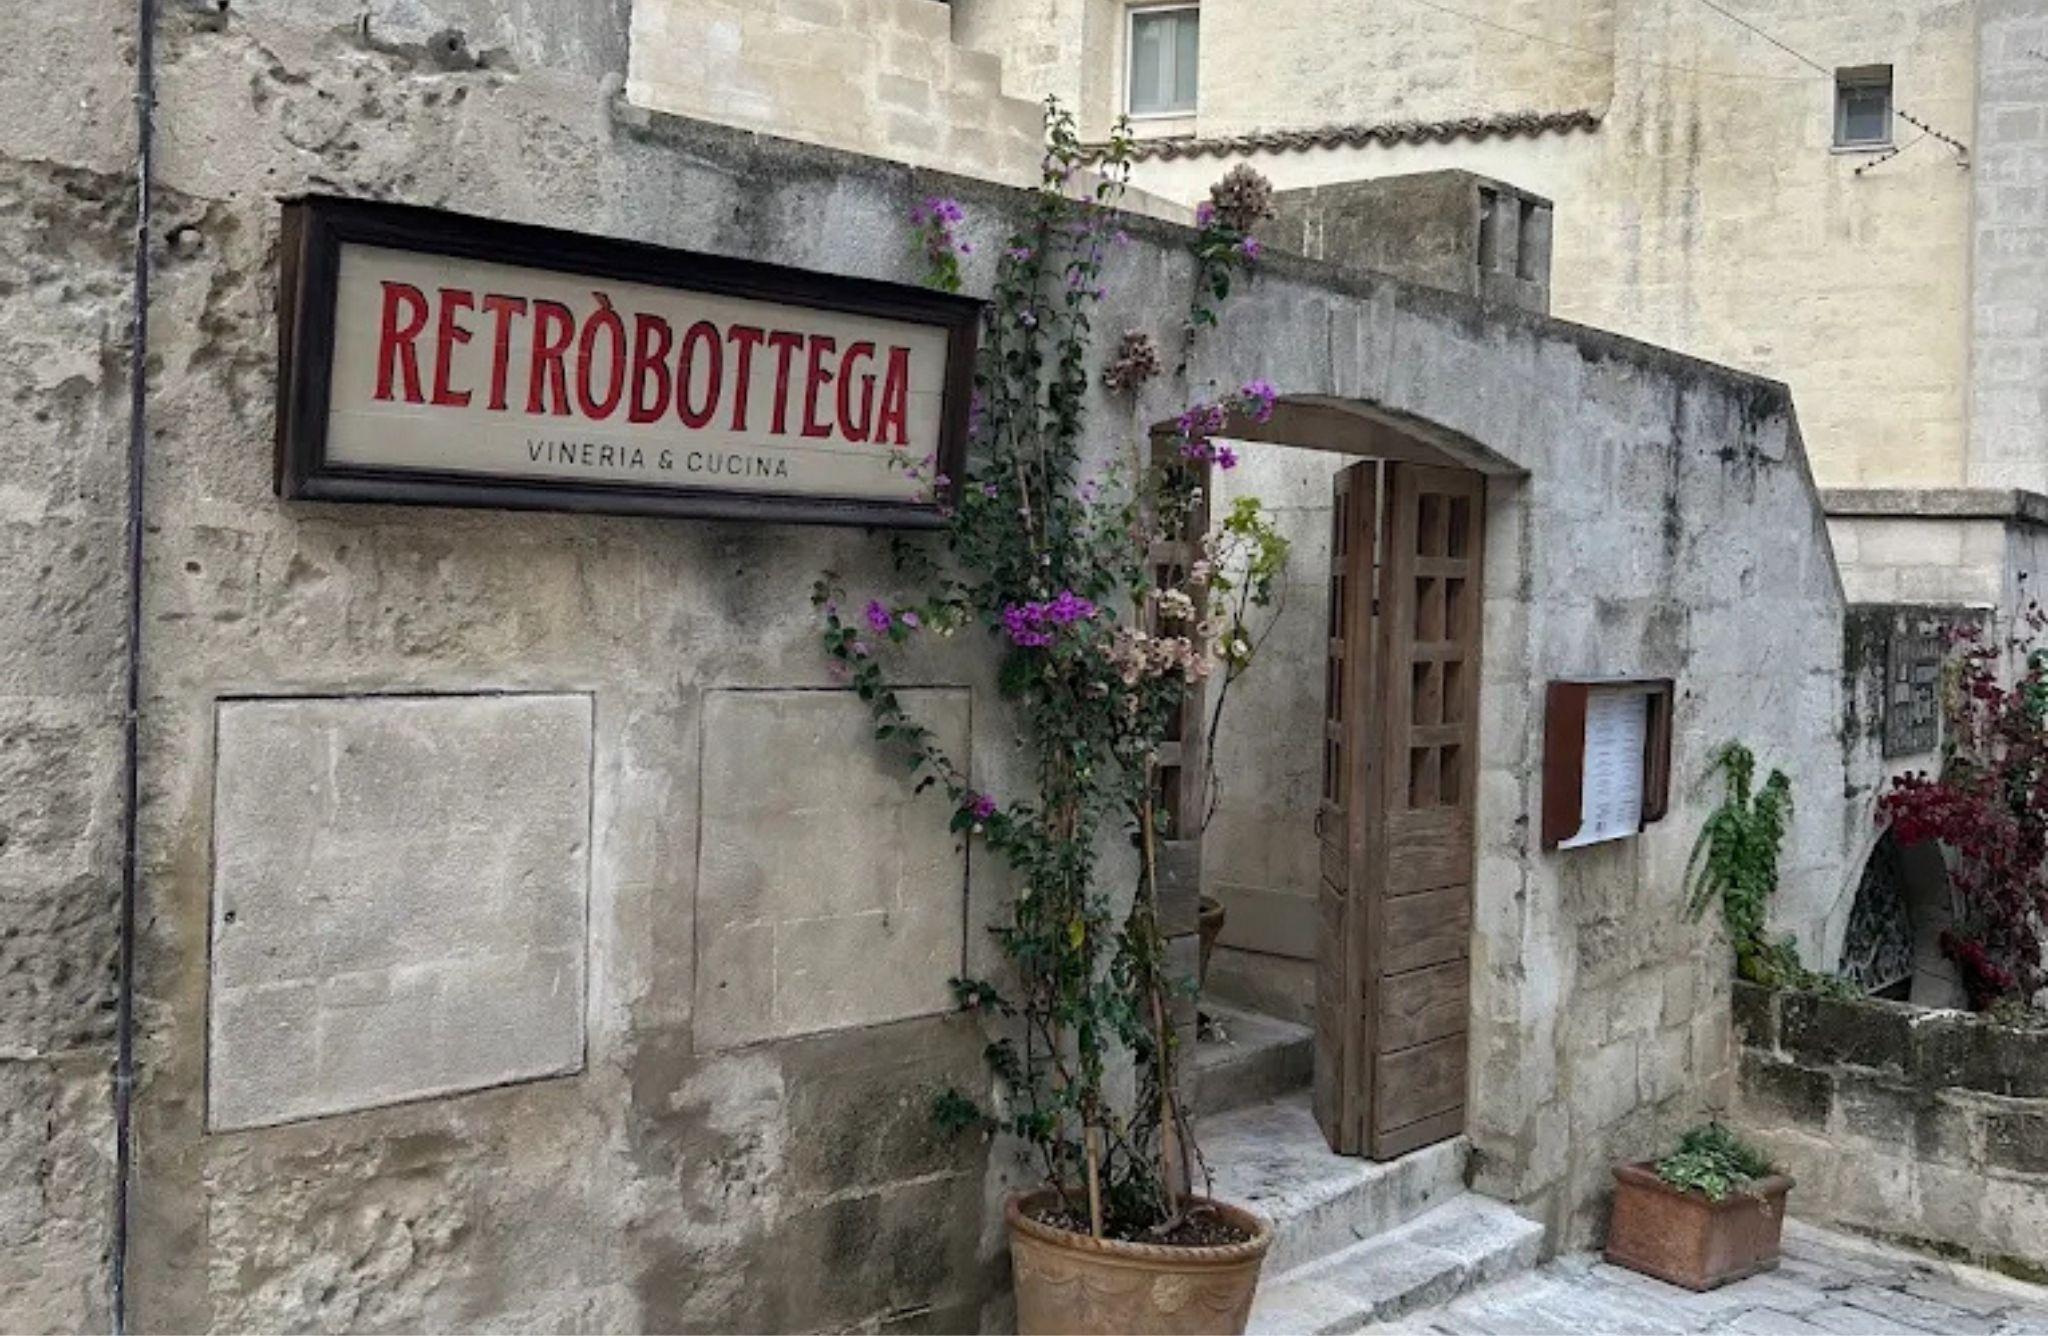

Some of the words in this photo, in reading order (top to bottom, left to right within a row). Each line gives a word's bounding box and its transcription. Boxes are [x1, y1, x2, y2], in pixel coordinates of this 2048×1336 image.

[373, 281, 911, 445] RETRÒBOTTEGA
[528, 440, 645, 469] VINERIA
[658, 450, 674, 471] &
[688, 451, 789, 478] CUCINA
